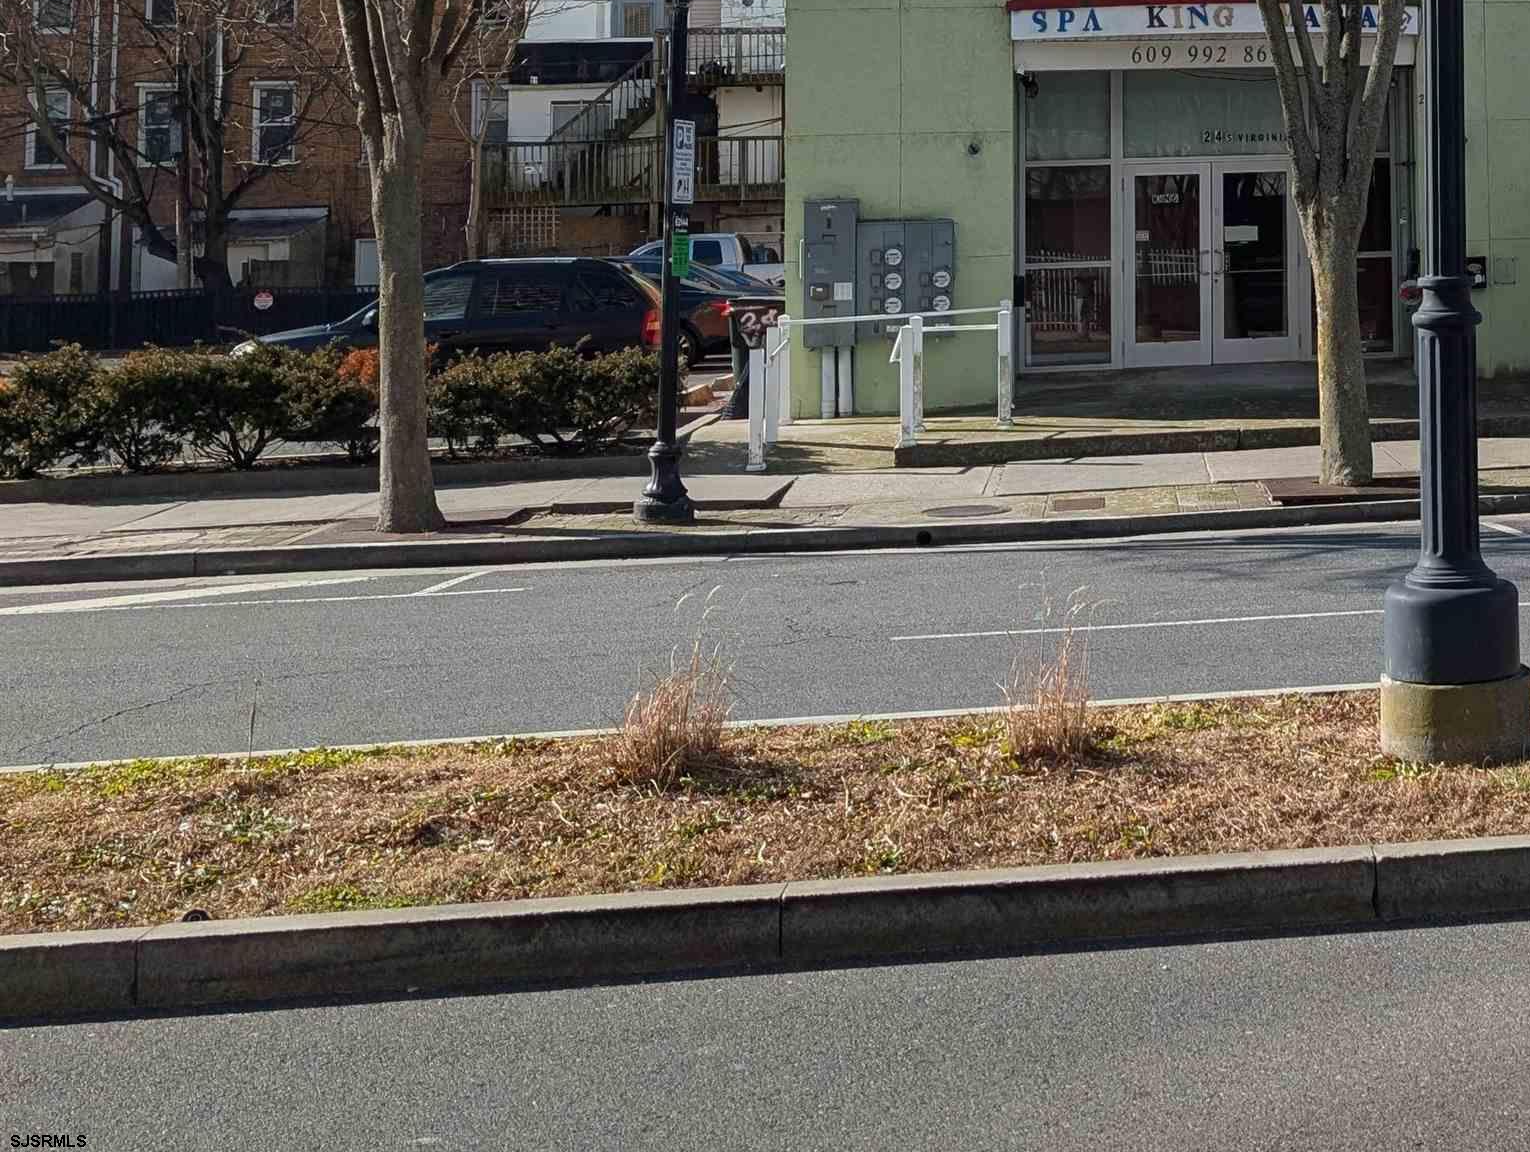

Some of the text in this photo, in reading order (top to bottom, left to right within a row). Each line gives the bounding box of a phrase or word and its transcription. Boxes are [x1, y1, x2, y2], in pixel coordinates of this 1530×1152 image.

[1031, 4, 1235, 33] SPA KING
[1131, 45, 1272, 64] 609 992 86
